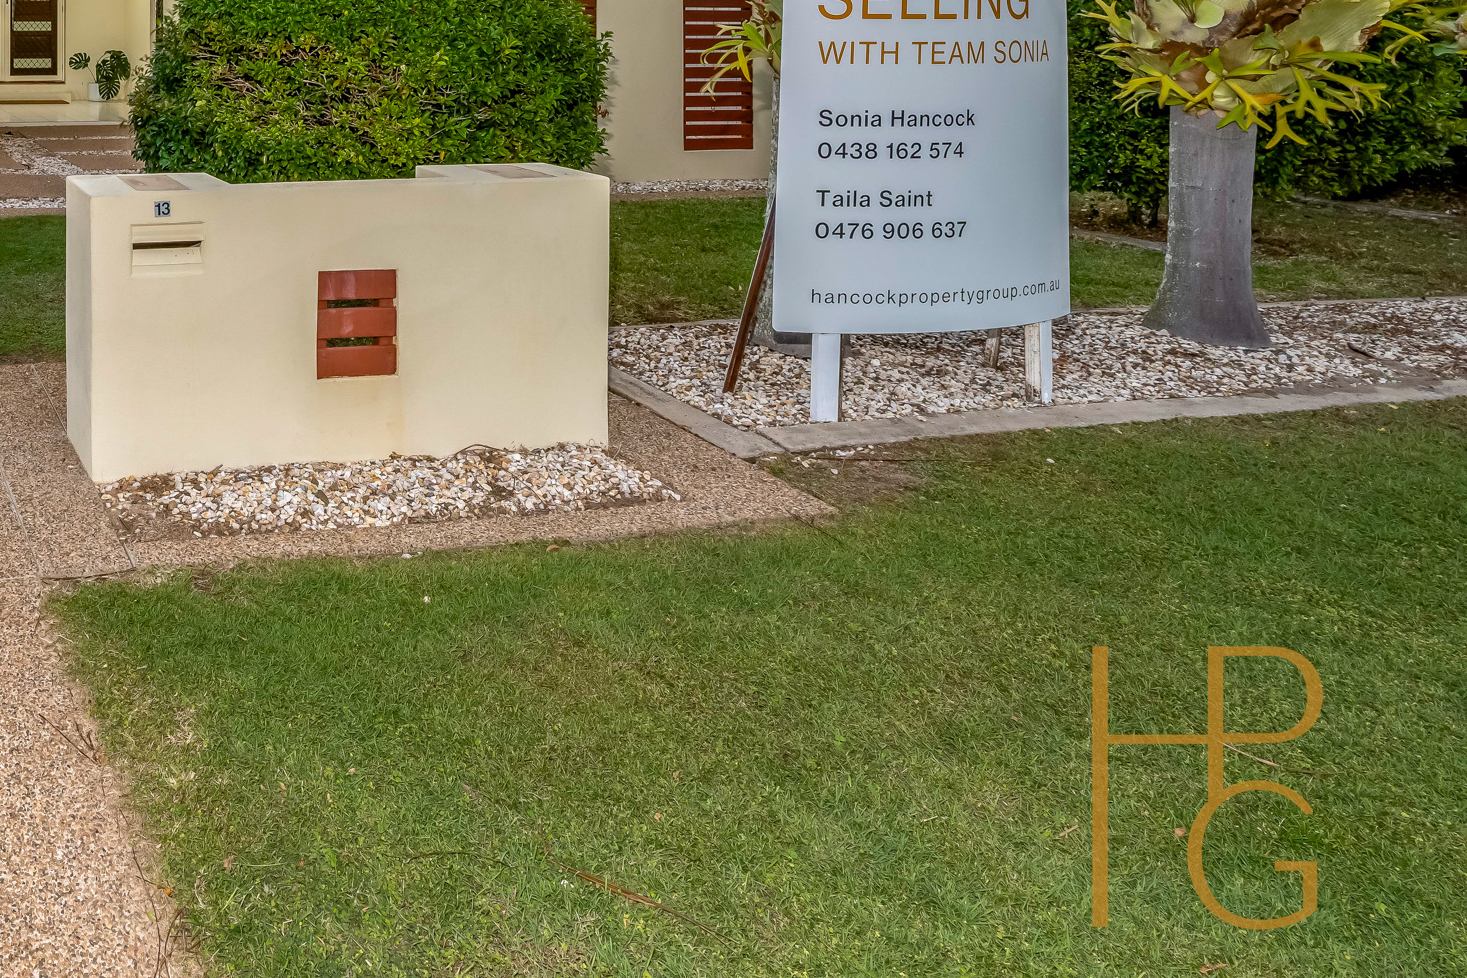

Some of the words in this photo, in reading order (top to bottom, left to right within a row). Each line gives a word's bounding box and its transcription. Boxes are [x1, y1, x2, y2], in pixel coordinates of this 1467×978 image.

[818, 40, 899, 65] WITH
[911, 40, 985, 65] TEAM
[993, 39, 1050, 64] SONIA
[818, 108, 882, 128] Sonia
[890, 108, 976, 127] Hancock
[817, 141, 878, 160] 0438
[886, 141, 922, 160] 162
[929, 141, 964, 159] 574
[816, 189, 871, 208] Taila
[879, 189, 933, 208] Saint
[154, 201, 171, 217] 13
[815, 222, 874, 240] 0476
[882, 221, 924, 240] 906
[931, 221, 967, 239] 637
[811, 278, 1060, 307] hancockpropertygroup.com.au
